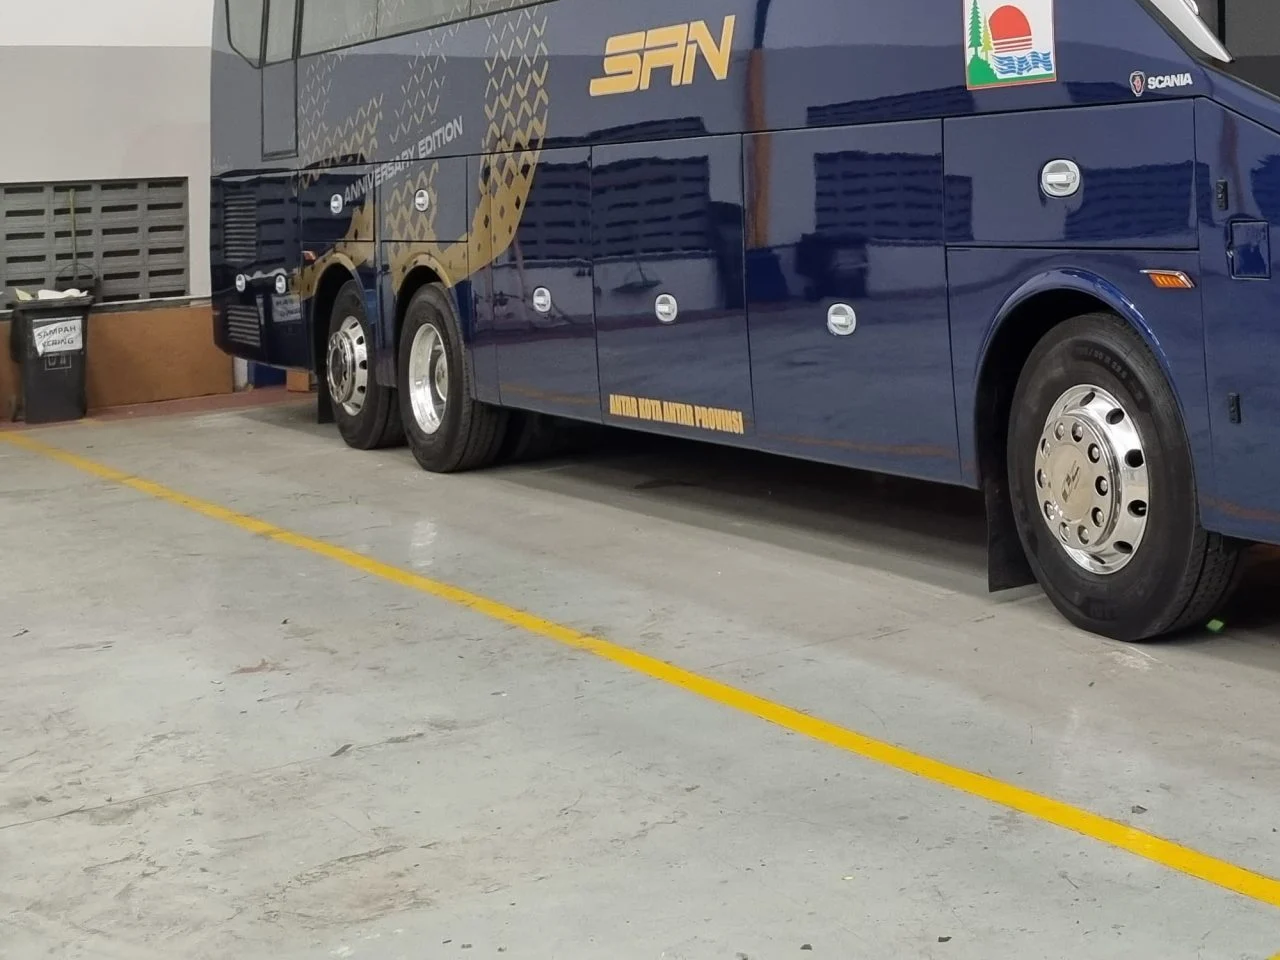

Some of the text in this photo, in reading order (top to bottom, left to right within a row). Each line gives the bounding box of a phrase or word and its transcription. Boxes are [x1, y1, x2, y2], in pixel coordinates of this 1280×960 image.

[589, 14, 736, 97] SAN
[1147, 73, 1193, 90] SCANIA
[344, 115, 464, 206] ANNIVERSARY EDITION
[36, 324, 77, 339] SAMPAH
